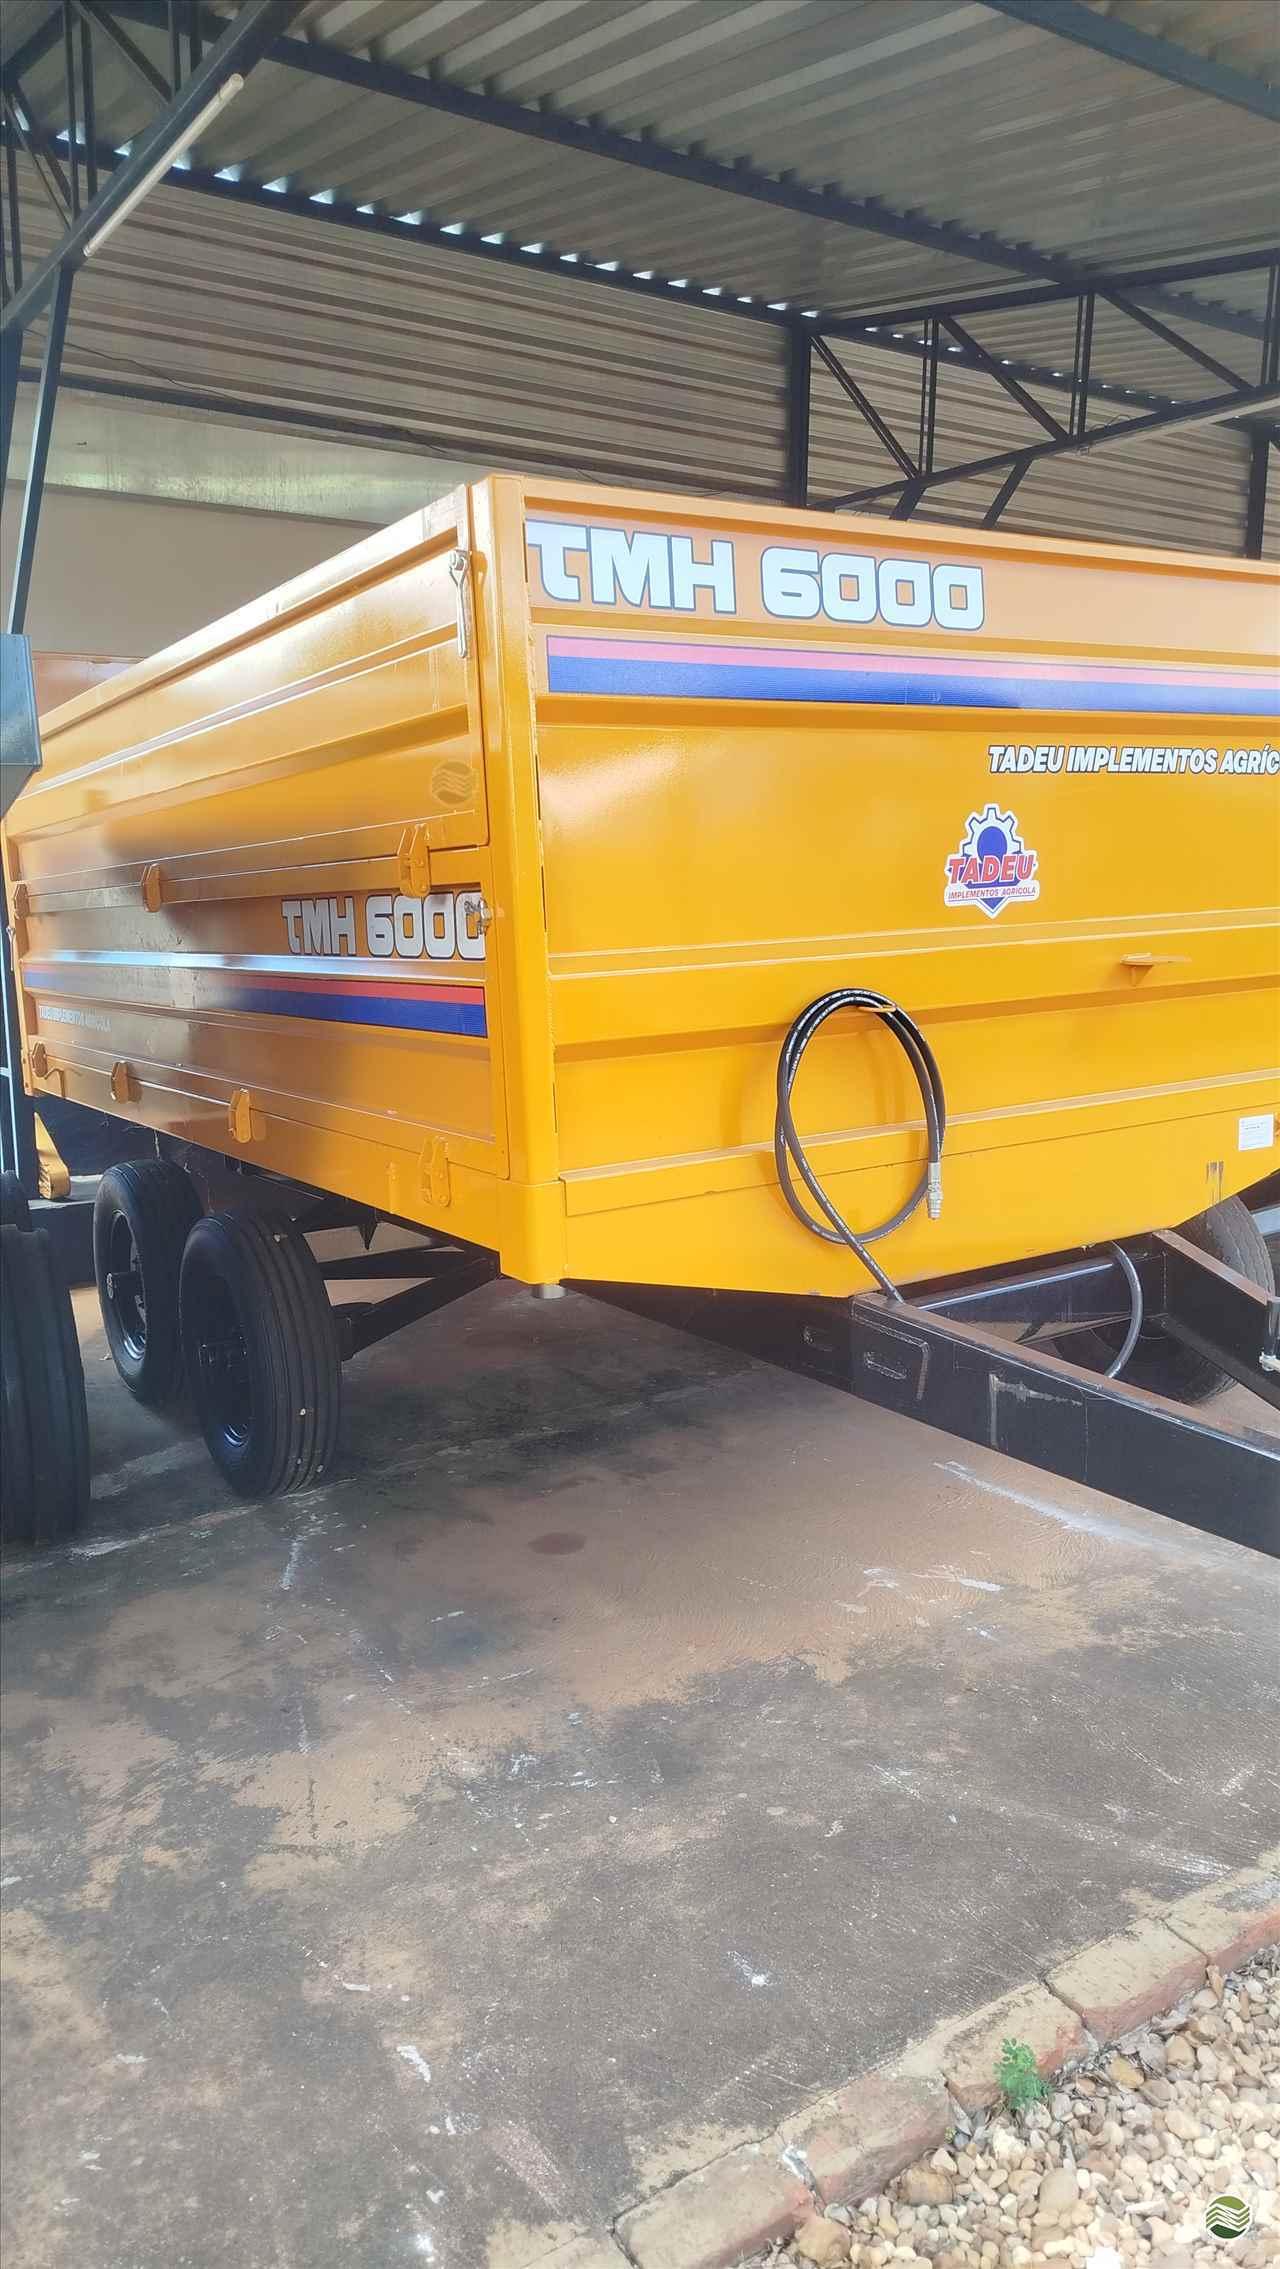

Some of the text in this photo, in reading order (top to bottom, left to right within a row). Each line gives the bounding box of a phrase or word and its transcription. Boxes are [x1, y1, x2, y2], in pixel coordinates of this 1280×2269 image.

[527, 518, 986, 631] TMH 6000
[988, 744, 1065, 774] TADEU
[1067, 746, 1218, 775] IMPLEMENTOS
[949, 854, 1035, 884] TADEU
[947, 888, 999, 900] IMPLEMENTOS
[281, 889, 486, 960] TMH 6000
